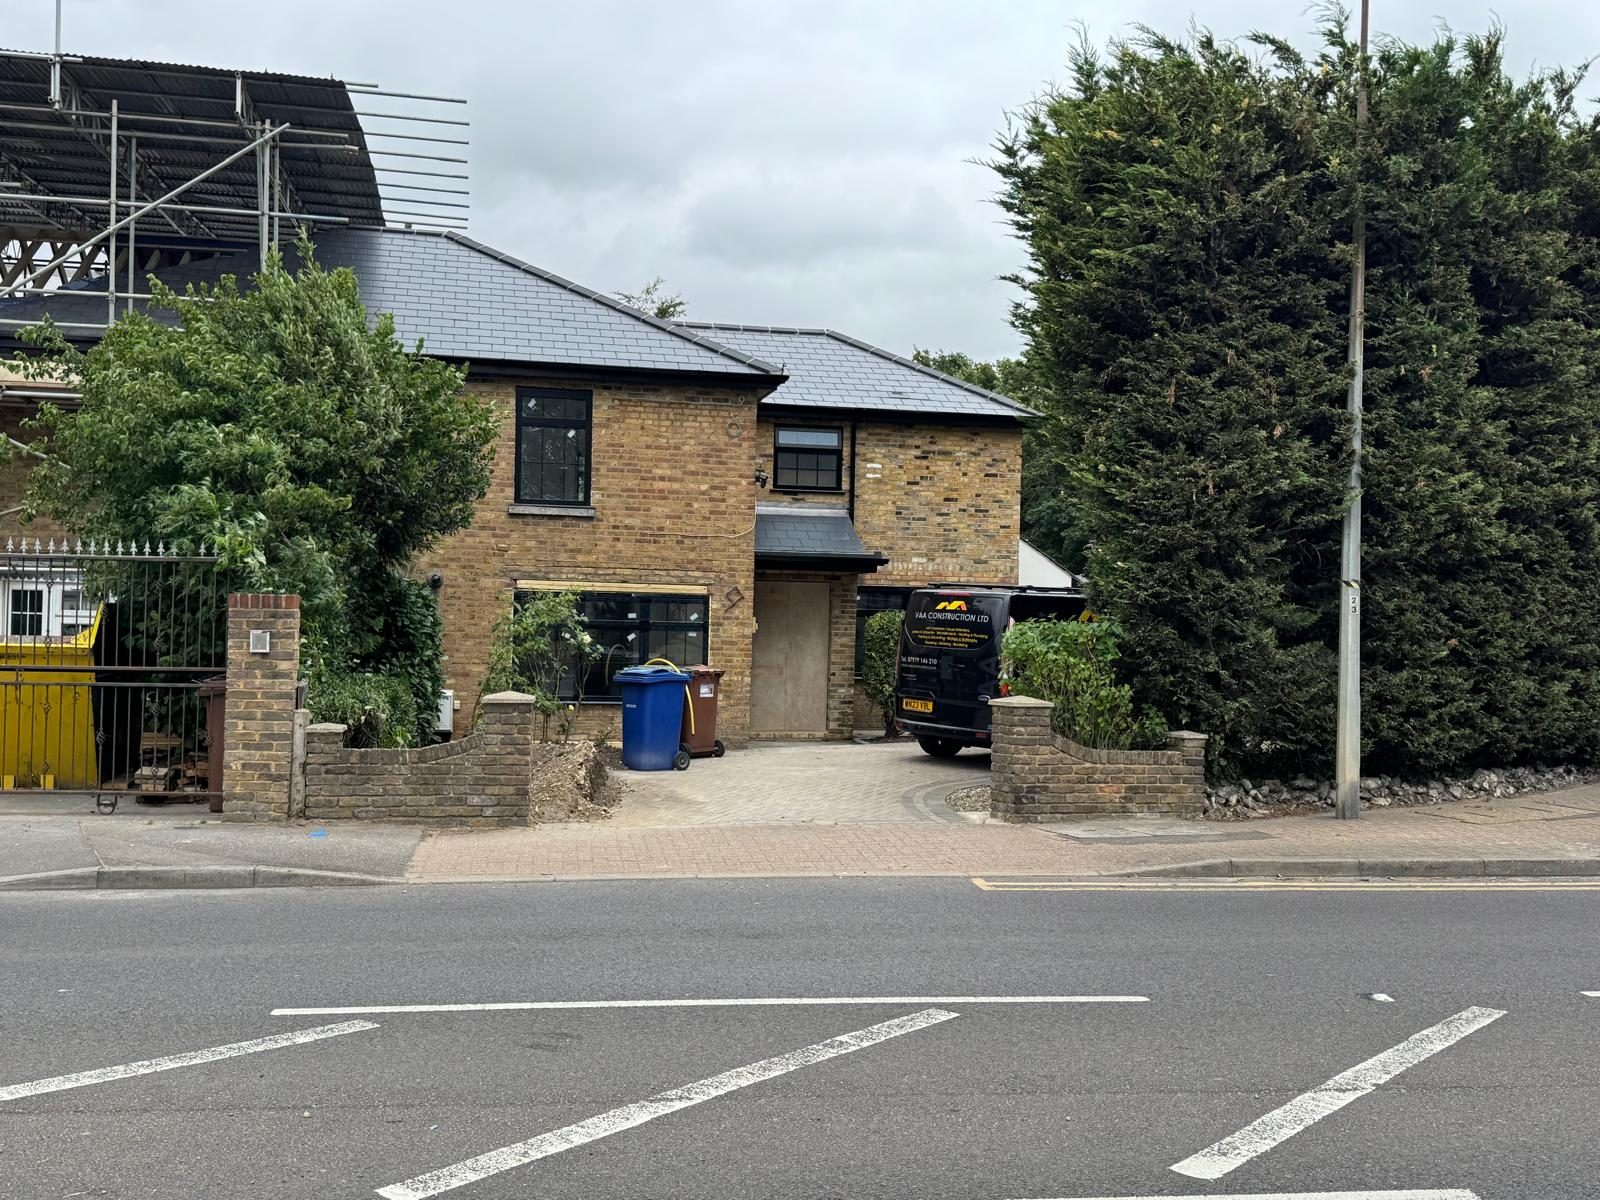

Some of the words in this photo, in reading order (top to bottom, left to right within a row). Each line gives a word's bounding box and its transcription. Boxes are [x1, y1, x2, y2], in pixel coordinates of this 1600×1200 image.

[915, 611, 927, 619] VAA
[927, 612, 976, 622] CONSTRUCTION
[977, 615, 989, 623] LTD
